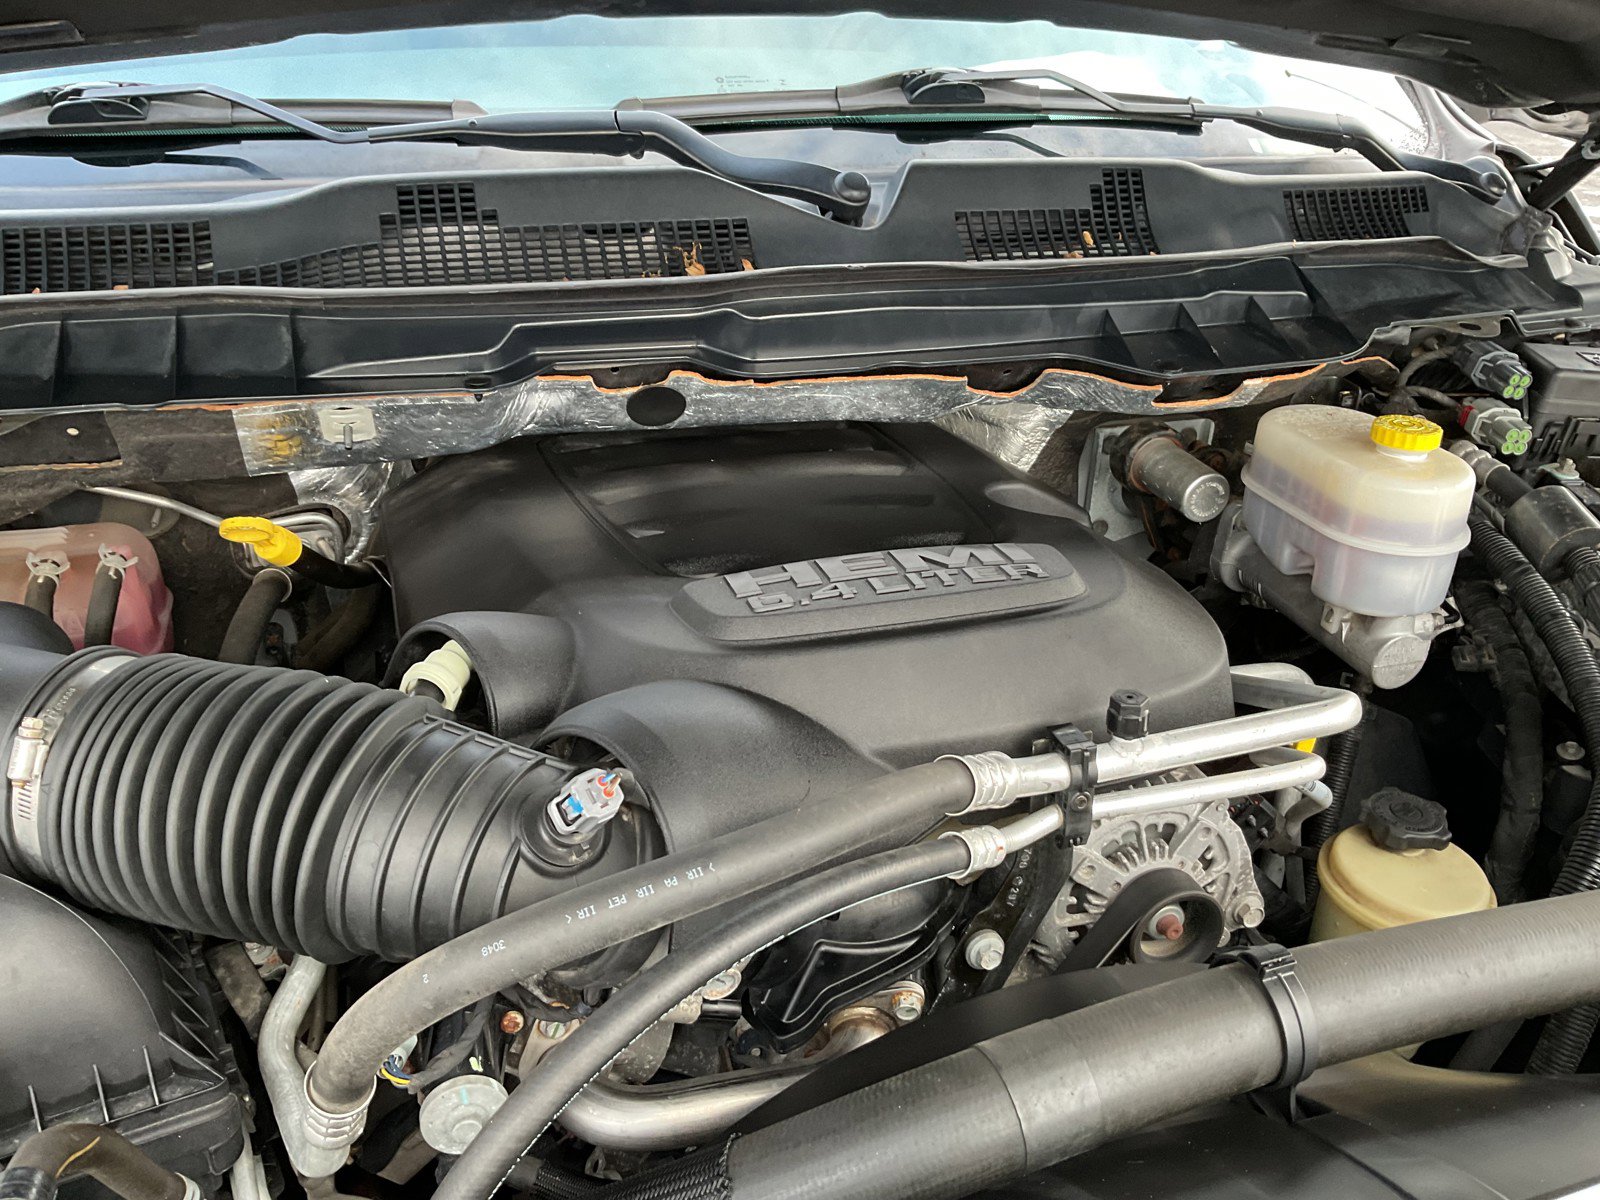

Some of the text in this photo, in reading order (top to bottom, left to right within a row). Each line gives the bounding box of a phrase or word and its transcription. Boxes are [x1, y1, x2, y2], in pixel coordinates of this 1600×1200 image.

[723, 543, 1037, 598] HEMI
[866, 563, 1049, 595] LITER
[685, 866, 704, 880] IIR
[663, 875, 679, 888] PA
[635, 884, 656, 898] IIR
[608, 893, 628, 909] PET
[576, 904, 597, 920] IIR
